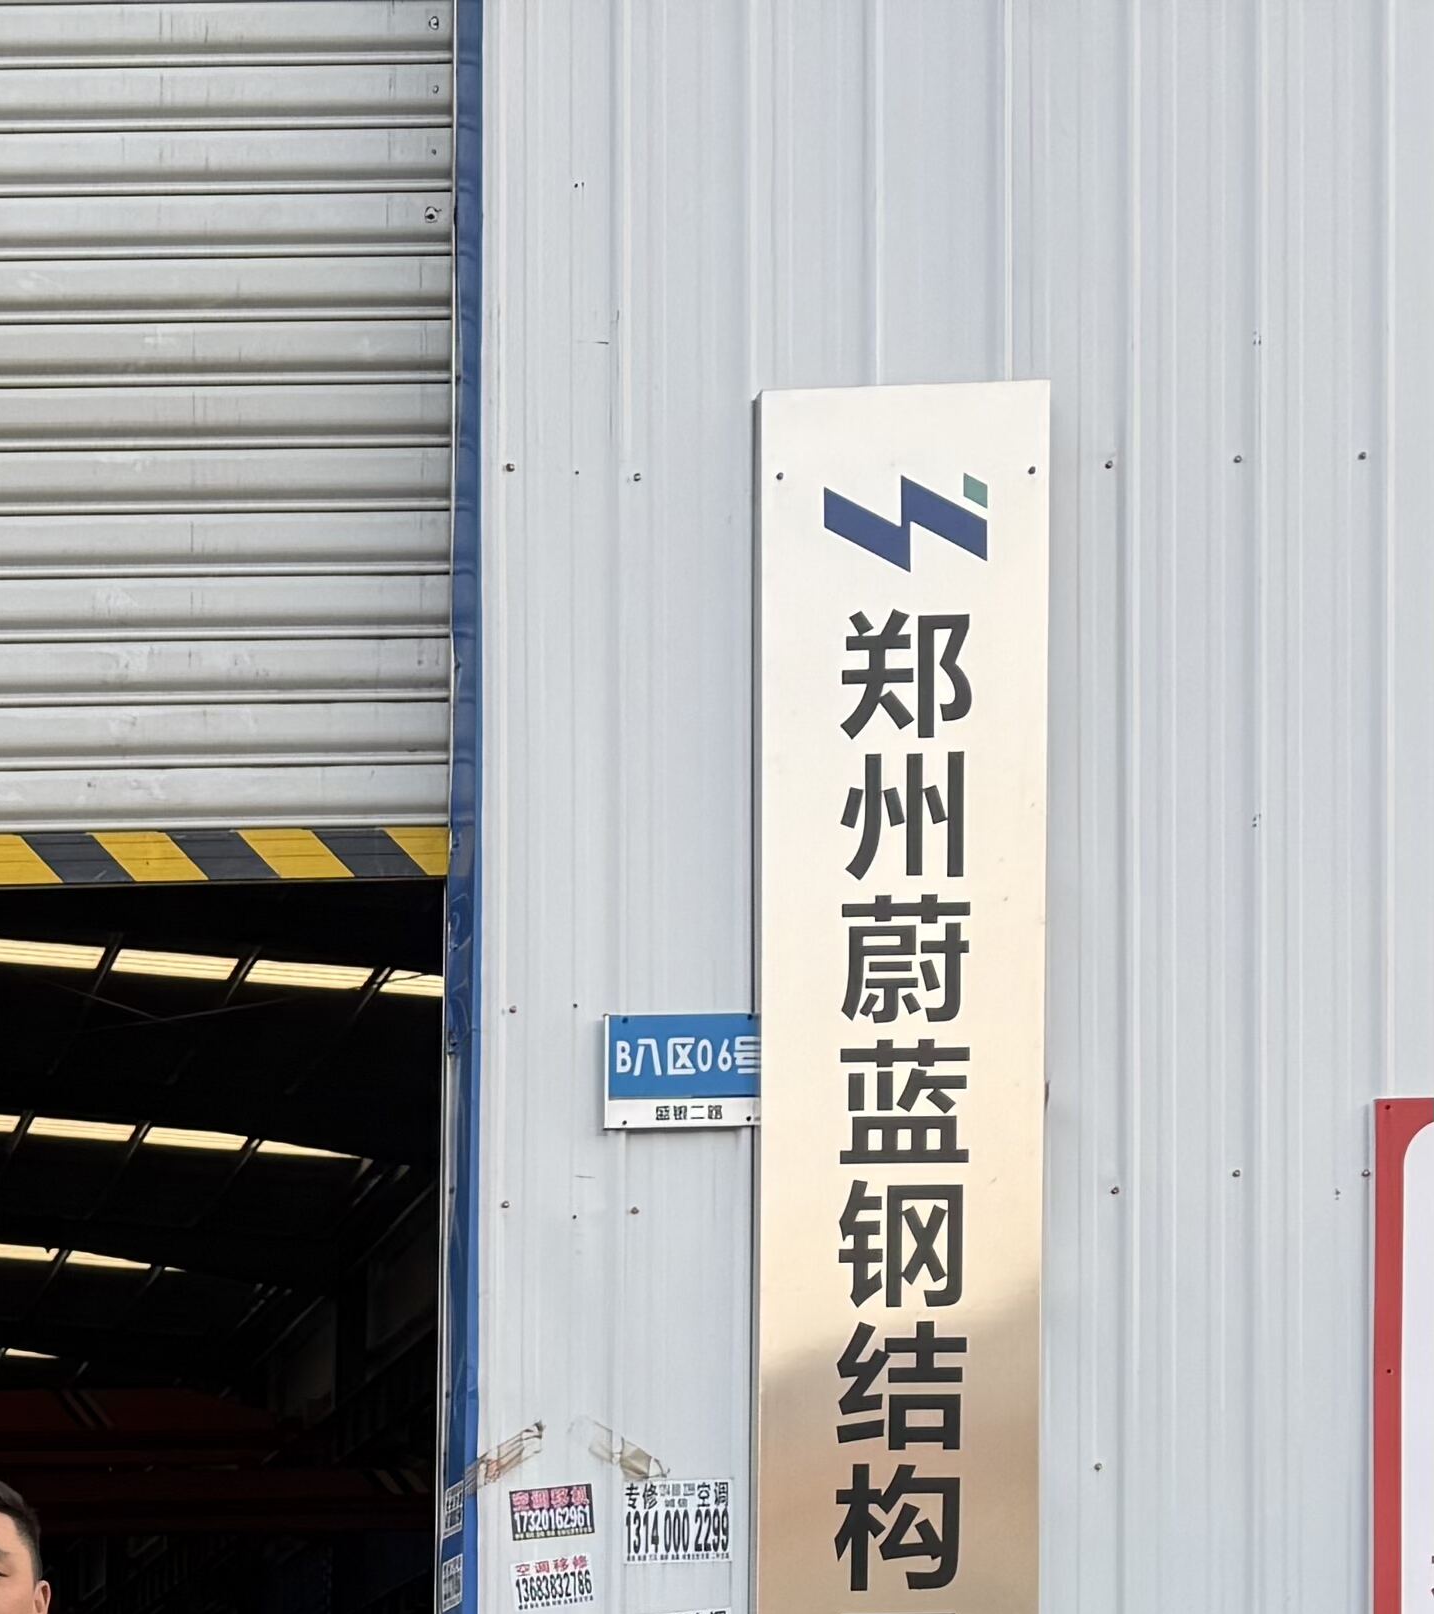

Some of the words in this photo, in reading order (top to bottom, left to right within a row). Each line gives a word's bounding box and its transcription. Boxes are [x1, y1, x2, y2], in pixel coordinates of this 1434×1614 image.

[697, 1481, 729, 1508] 空调
[626, 1510, 660, 1554] 1314
[664, 1509, 690, 1553] 000
[694, 1508, 729, 1552] 2299
